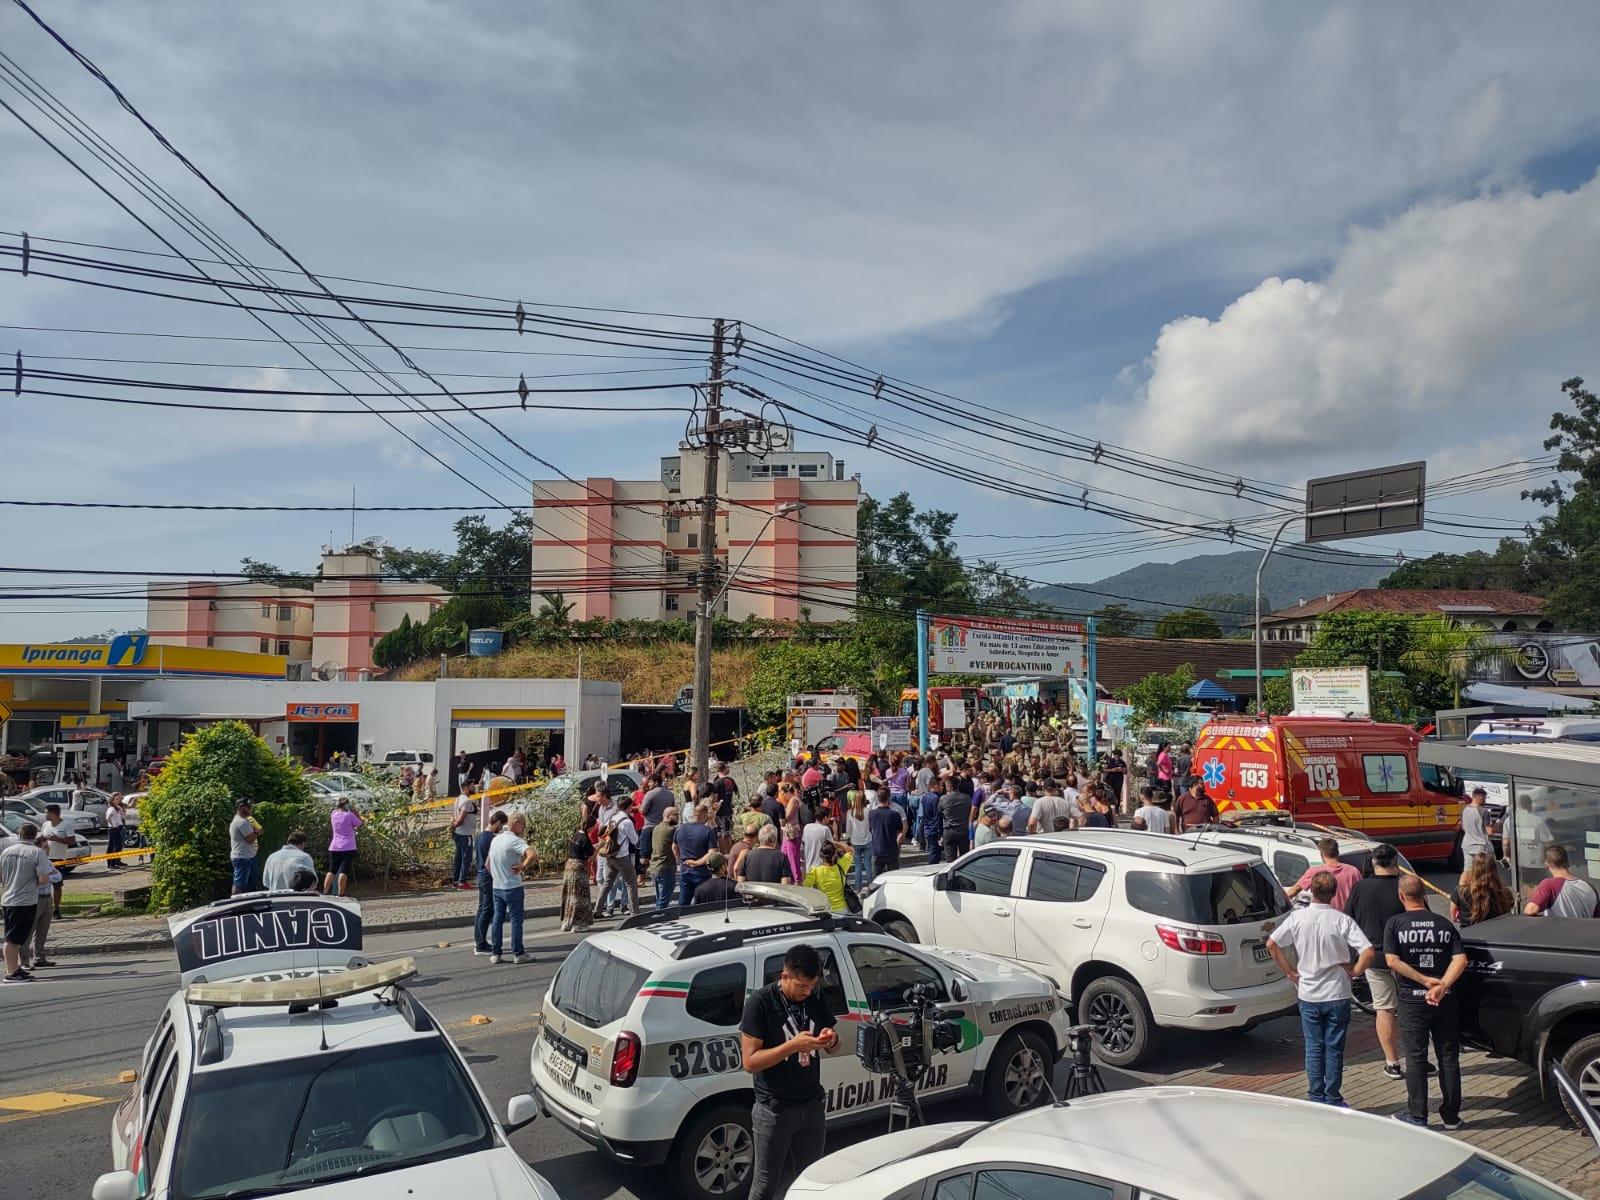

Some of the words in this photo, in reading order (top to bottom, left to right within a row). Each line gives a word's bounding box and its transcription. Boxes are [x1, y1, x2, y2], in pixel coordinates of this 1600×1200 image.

[22, 645, 104, 664] Ipiranga
[969, 660, 1053, 672] #VEMPROCANTINHO
[1206, 725, 1269, 738] BOMBEIROS
[1239, 769, 1268, 789] 193
[1303, 764, 1340, 792] 193
[192, 907, 349, 960] CANIL
[752, 925, 793, 937] DUSTER
[1411, 920, 1435, 928] SOMOS
[1398, 929, 1435, 944] NOTA
[1438, 930, 1451, 944] 10
[668, 1035, 742, 1079] 3283
[826, 1080, 875, 1113] LÍCIA
